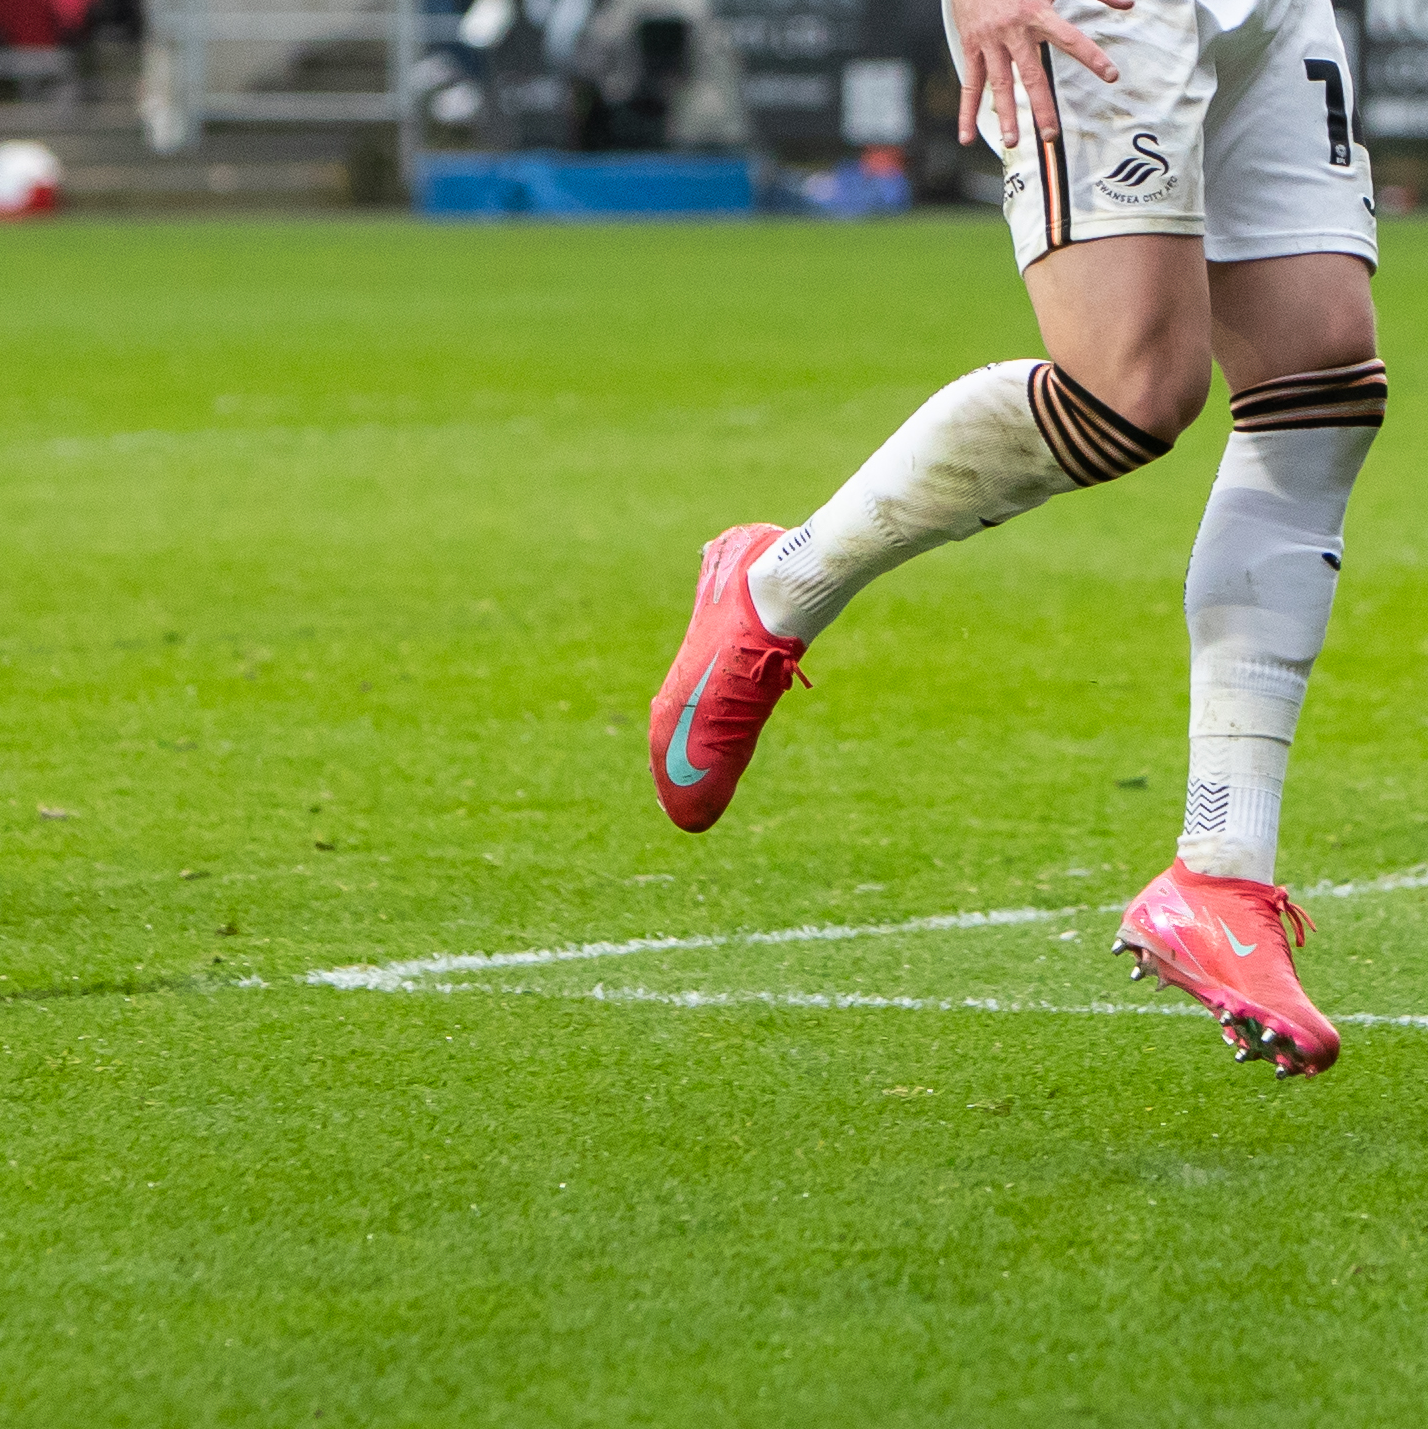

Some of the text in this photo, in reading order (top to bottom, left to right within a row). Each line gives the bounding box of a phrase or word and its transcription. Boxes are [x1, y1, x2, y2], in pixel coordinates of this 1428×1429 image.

[1094, 175, 1179, 203] SWANSEA CITY AFC
